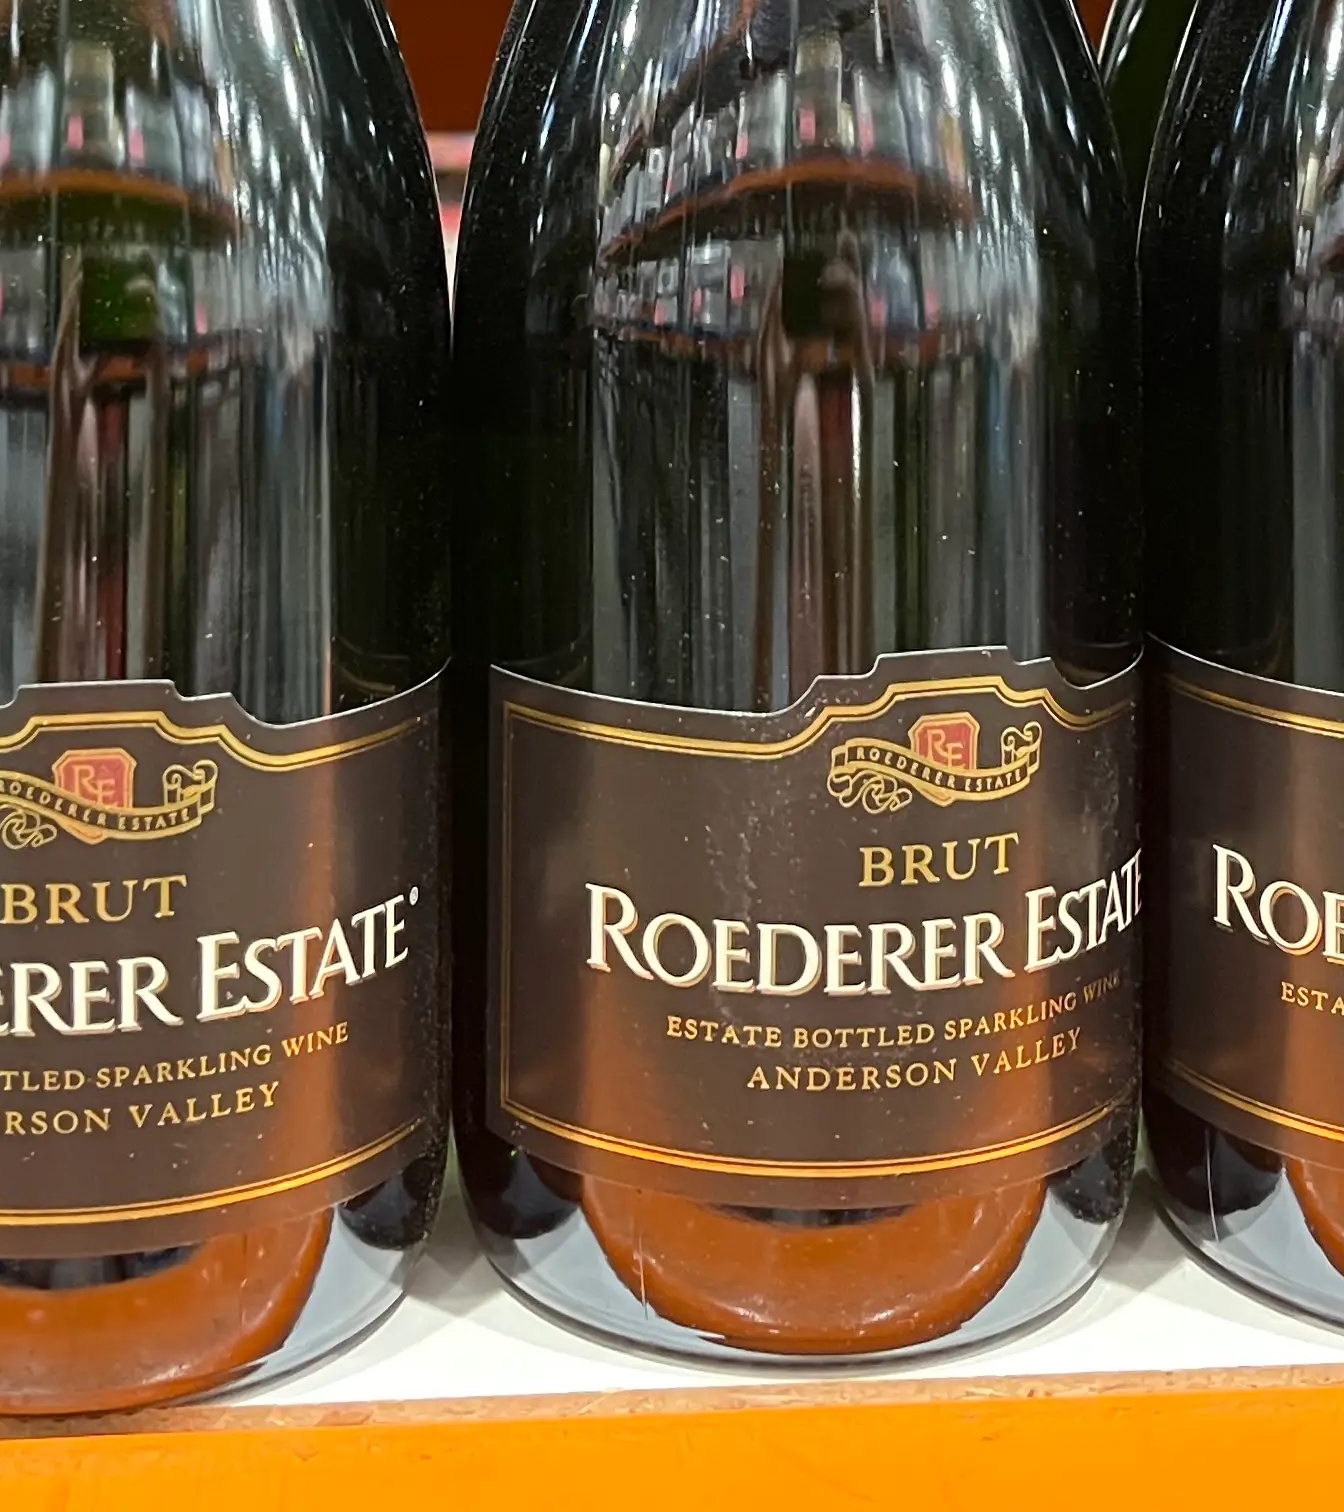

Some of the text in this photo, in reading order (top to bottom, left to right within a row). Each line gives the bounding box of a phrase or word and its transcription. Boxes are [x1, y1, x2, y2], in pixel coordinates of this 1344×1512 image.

[856, 747, 1023, 792] ROEDERER ESTATE
[118, 807, 191, 831] ESTATE
[858, 832, 1019, 887] BRUT
[0, 874, 188, 925] BRUT
[585, 883, 1016, 996] ROEDERER
[666, 1015, 783, 1048] ESTATE
[793, 1024, 936, 1049] BOTTLED
[944, 992, 1077, 1040] SPARKLING
[96, 1045, 272, 1089] SPARKLING
[281, 1021, 349, 1058] WINE
[747, 1026, 1081, 1091] ANDERSON VALLEY
[128, 1081, 280, 1129] VALLEY
